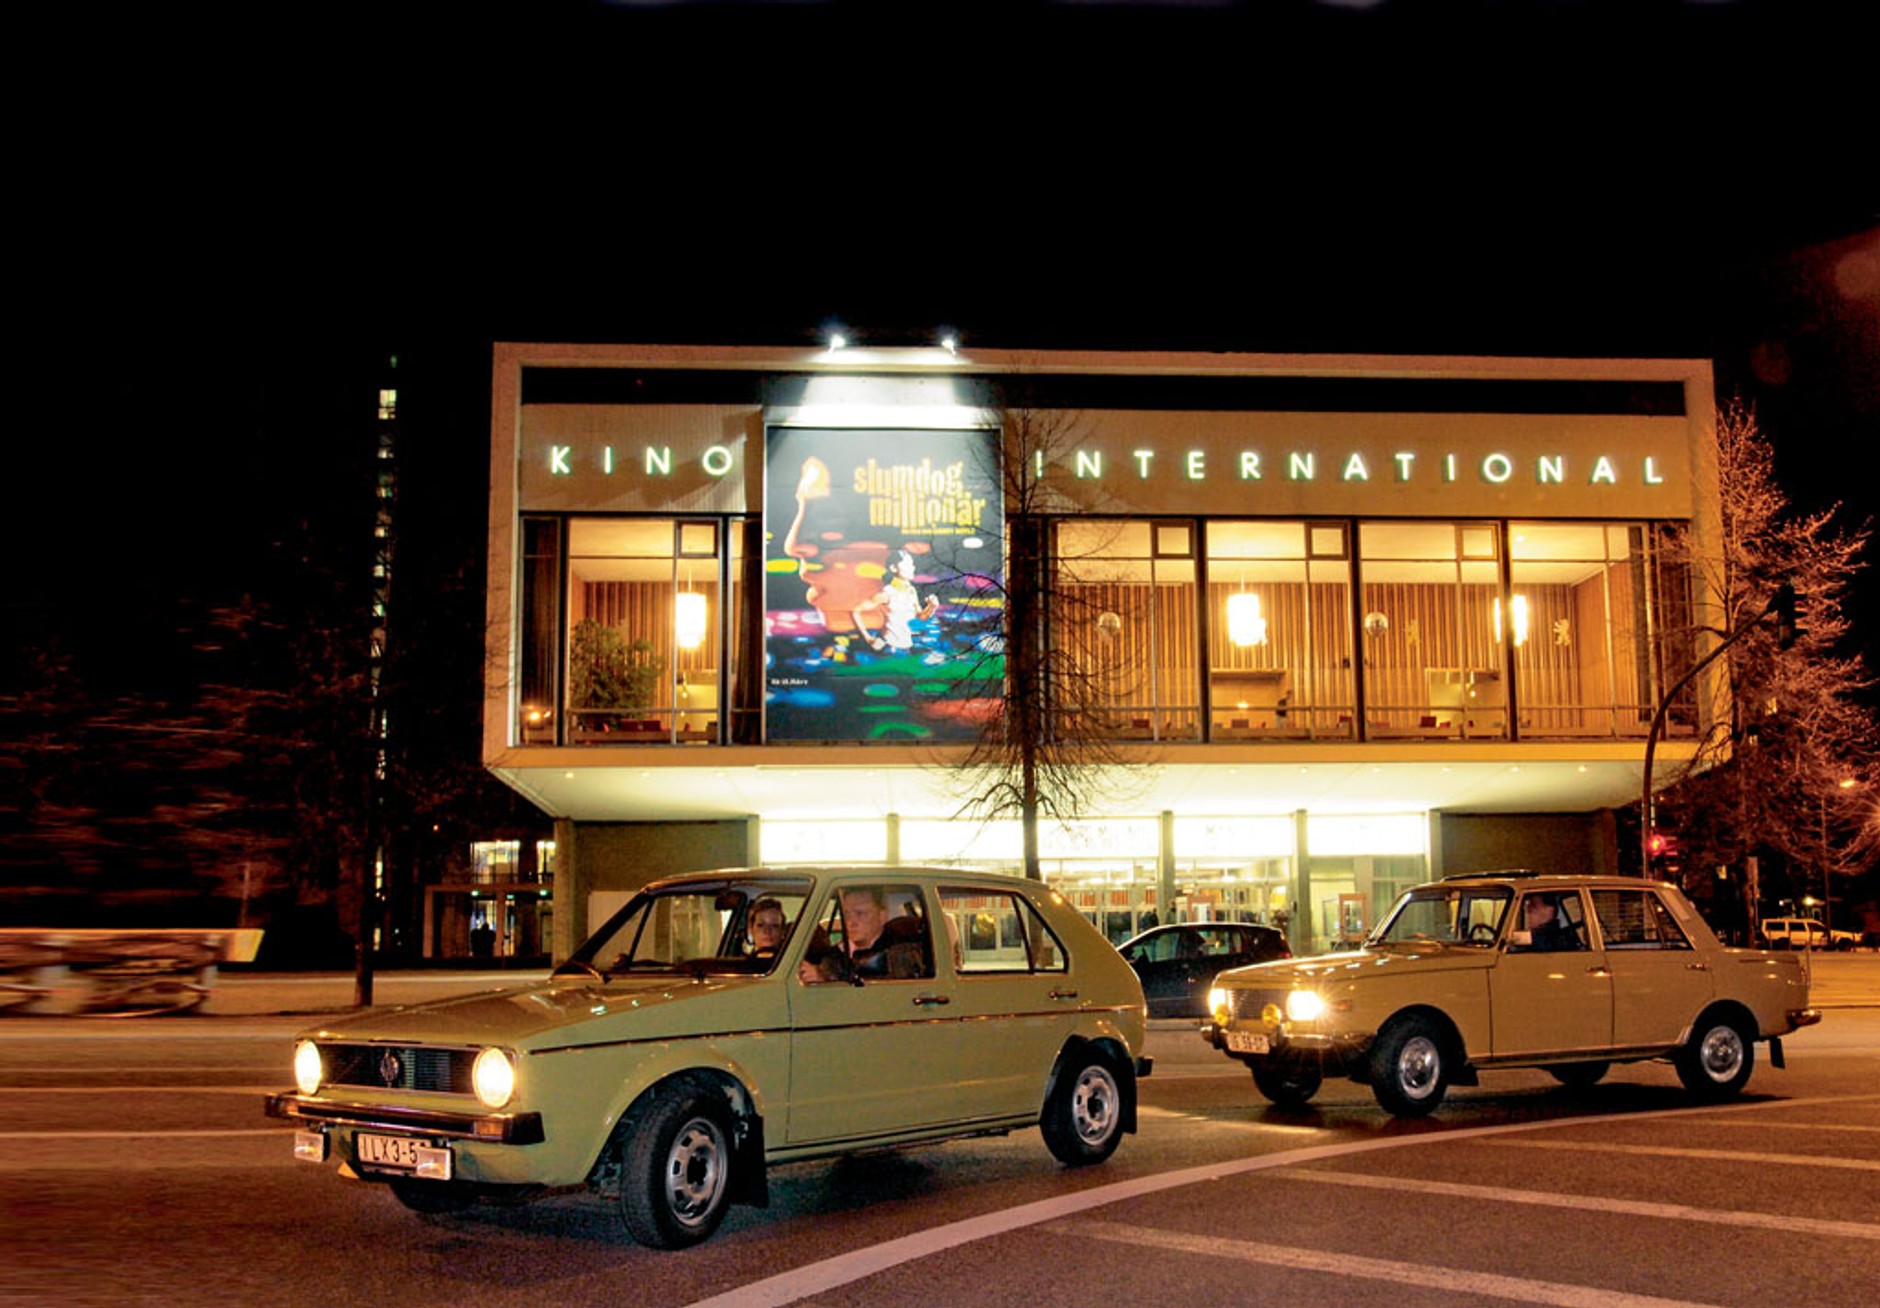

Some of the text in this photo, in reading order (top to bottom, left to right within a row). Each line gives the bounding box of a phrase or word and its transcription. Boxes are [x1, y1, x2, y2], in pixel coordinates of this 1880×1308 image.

[550, 445, 1663, 483] KINO INTERNATIONAL
[853, 458, 964, 499] slumdog
[362, 1135, 428, 1164] ILX3-5
